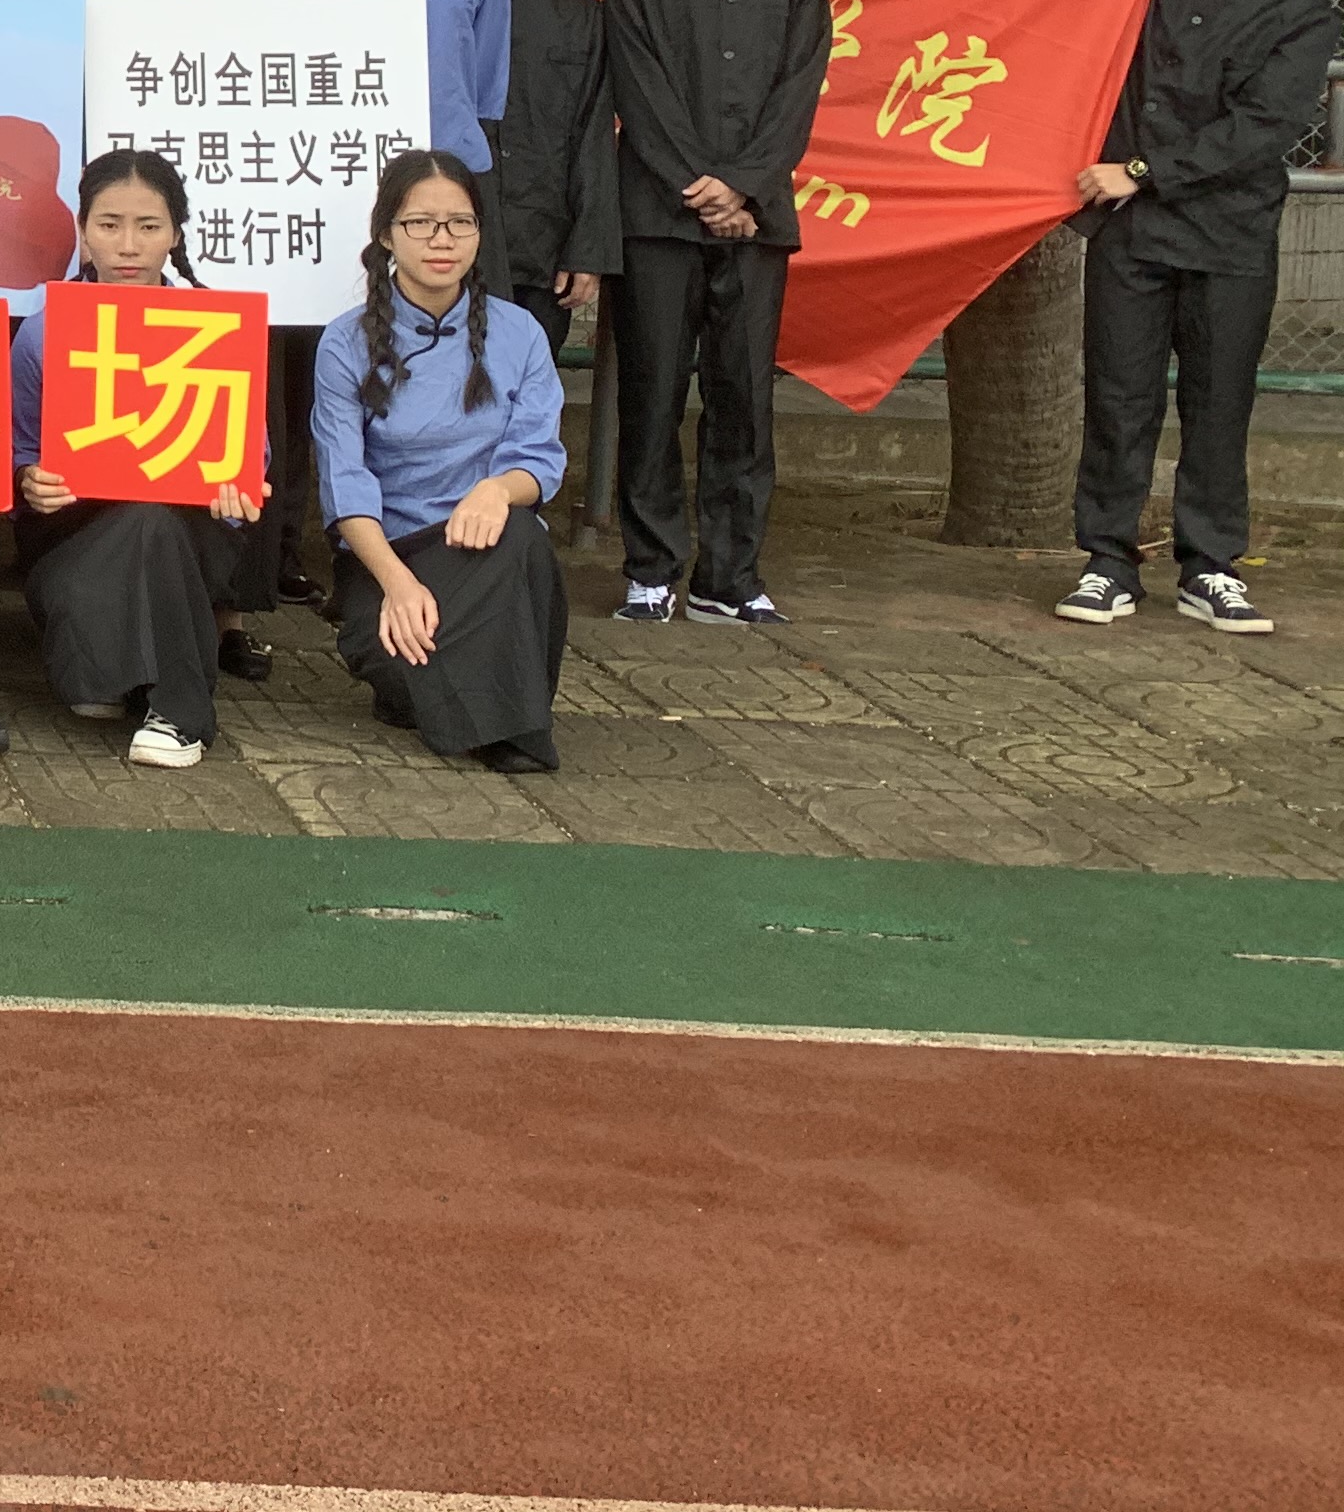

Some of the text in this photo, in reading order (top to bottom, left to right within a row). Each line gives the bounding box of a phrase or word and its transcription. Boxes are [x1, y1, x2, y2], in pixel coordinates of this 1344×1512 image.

[125, 50, 390, 108] 争创全国重点
[196, 207, 327, 266] 进行时
[63, 304, 252, 485] 场
